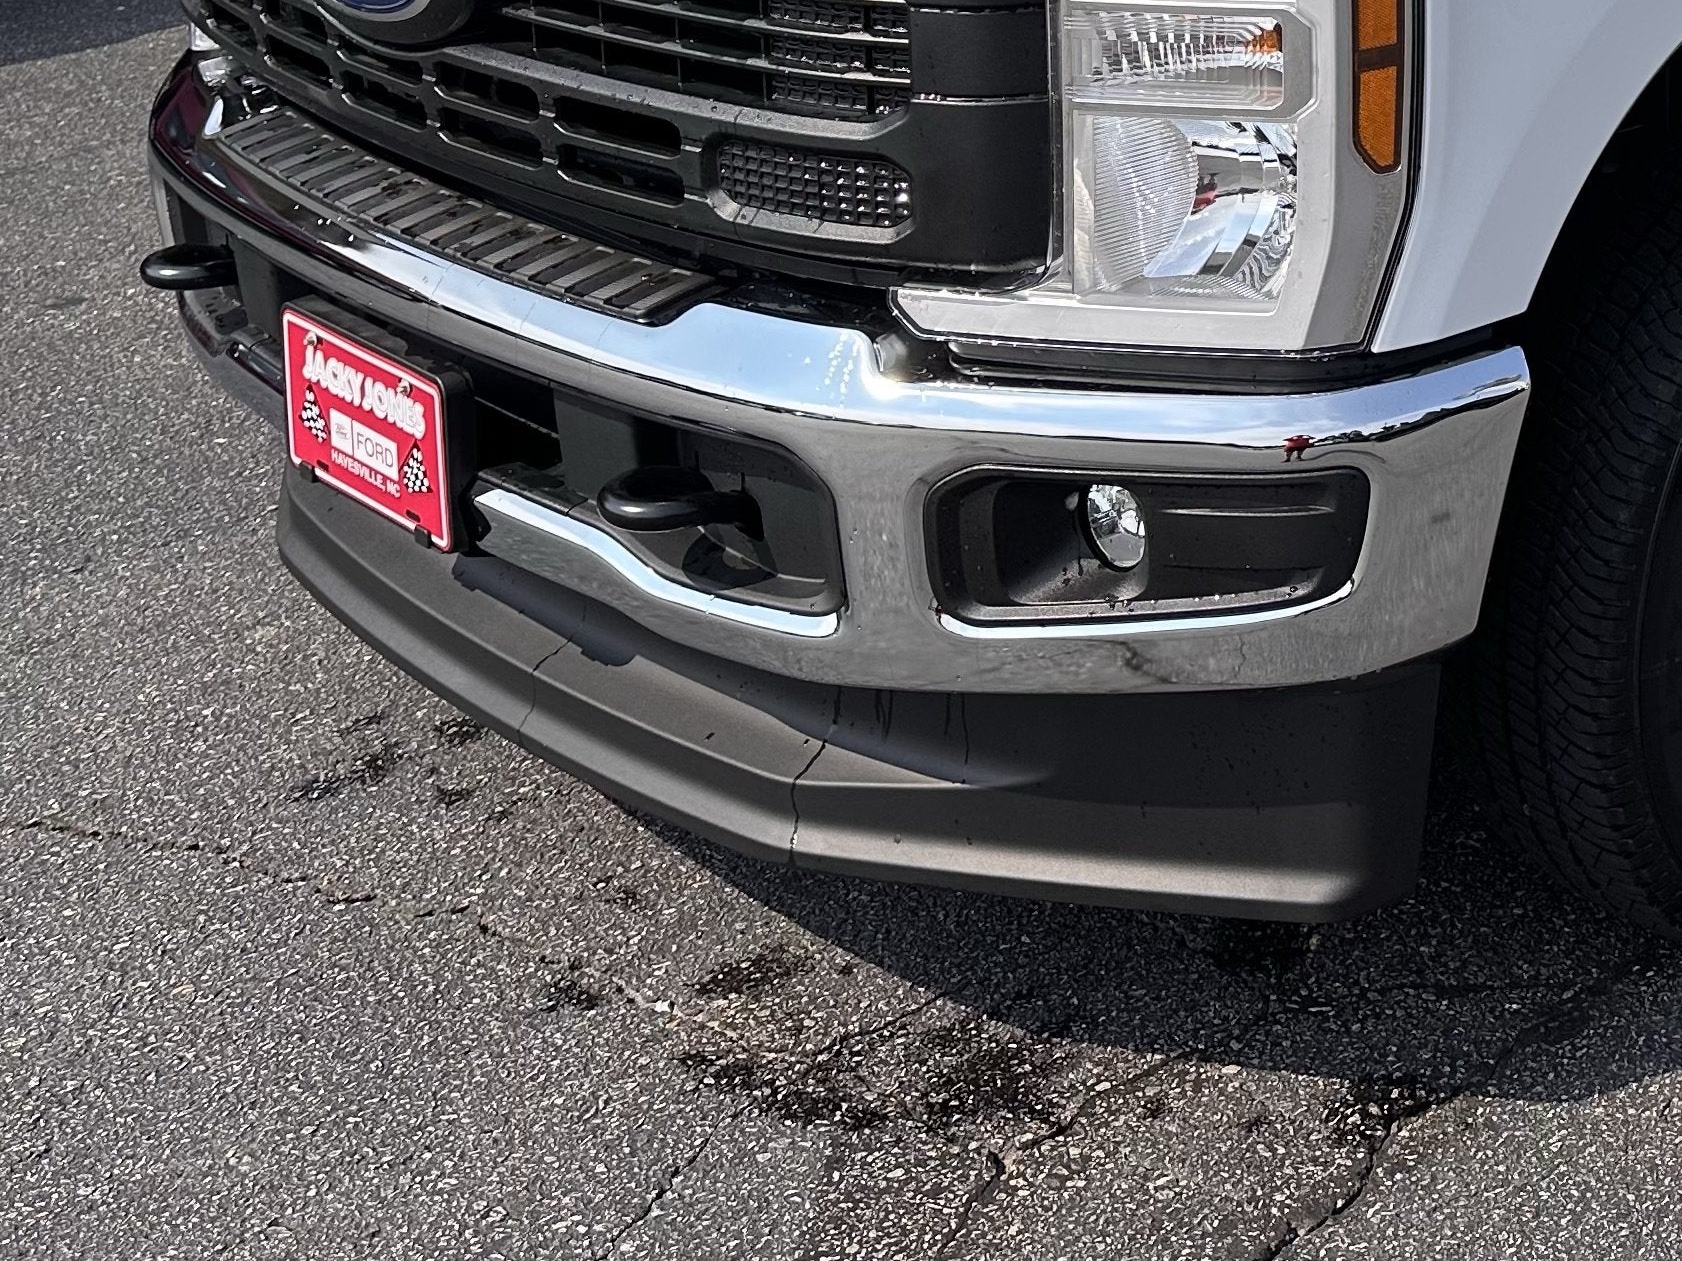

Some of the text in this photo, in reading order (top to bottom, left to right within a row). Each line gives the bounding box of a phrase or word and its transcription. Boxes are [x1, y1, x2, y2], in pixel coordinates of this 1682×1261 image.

[302, 344, 427, 440] JACKY JONES
[356, 431, 394, 468] FORD
[386, 479, 401, 499] NC
